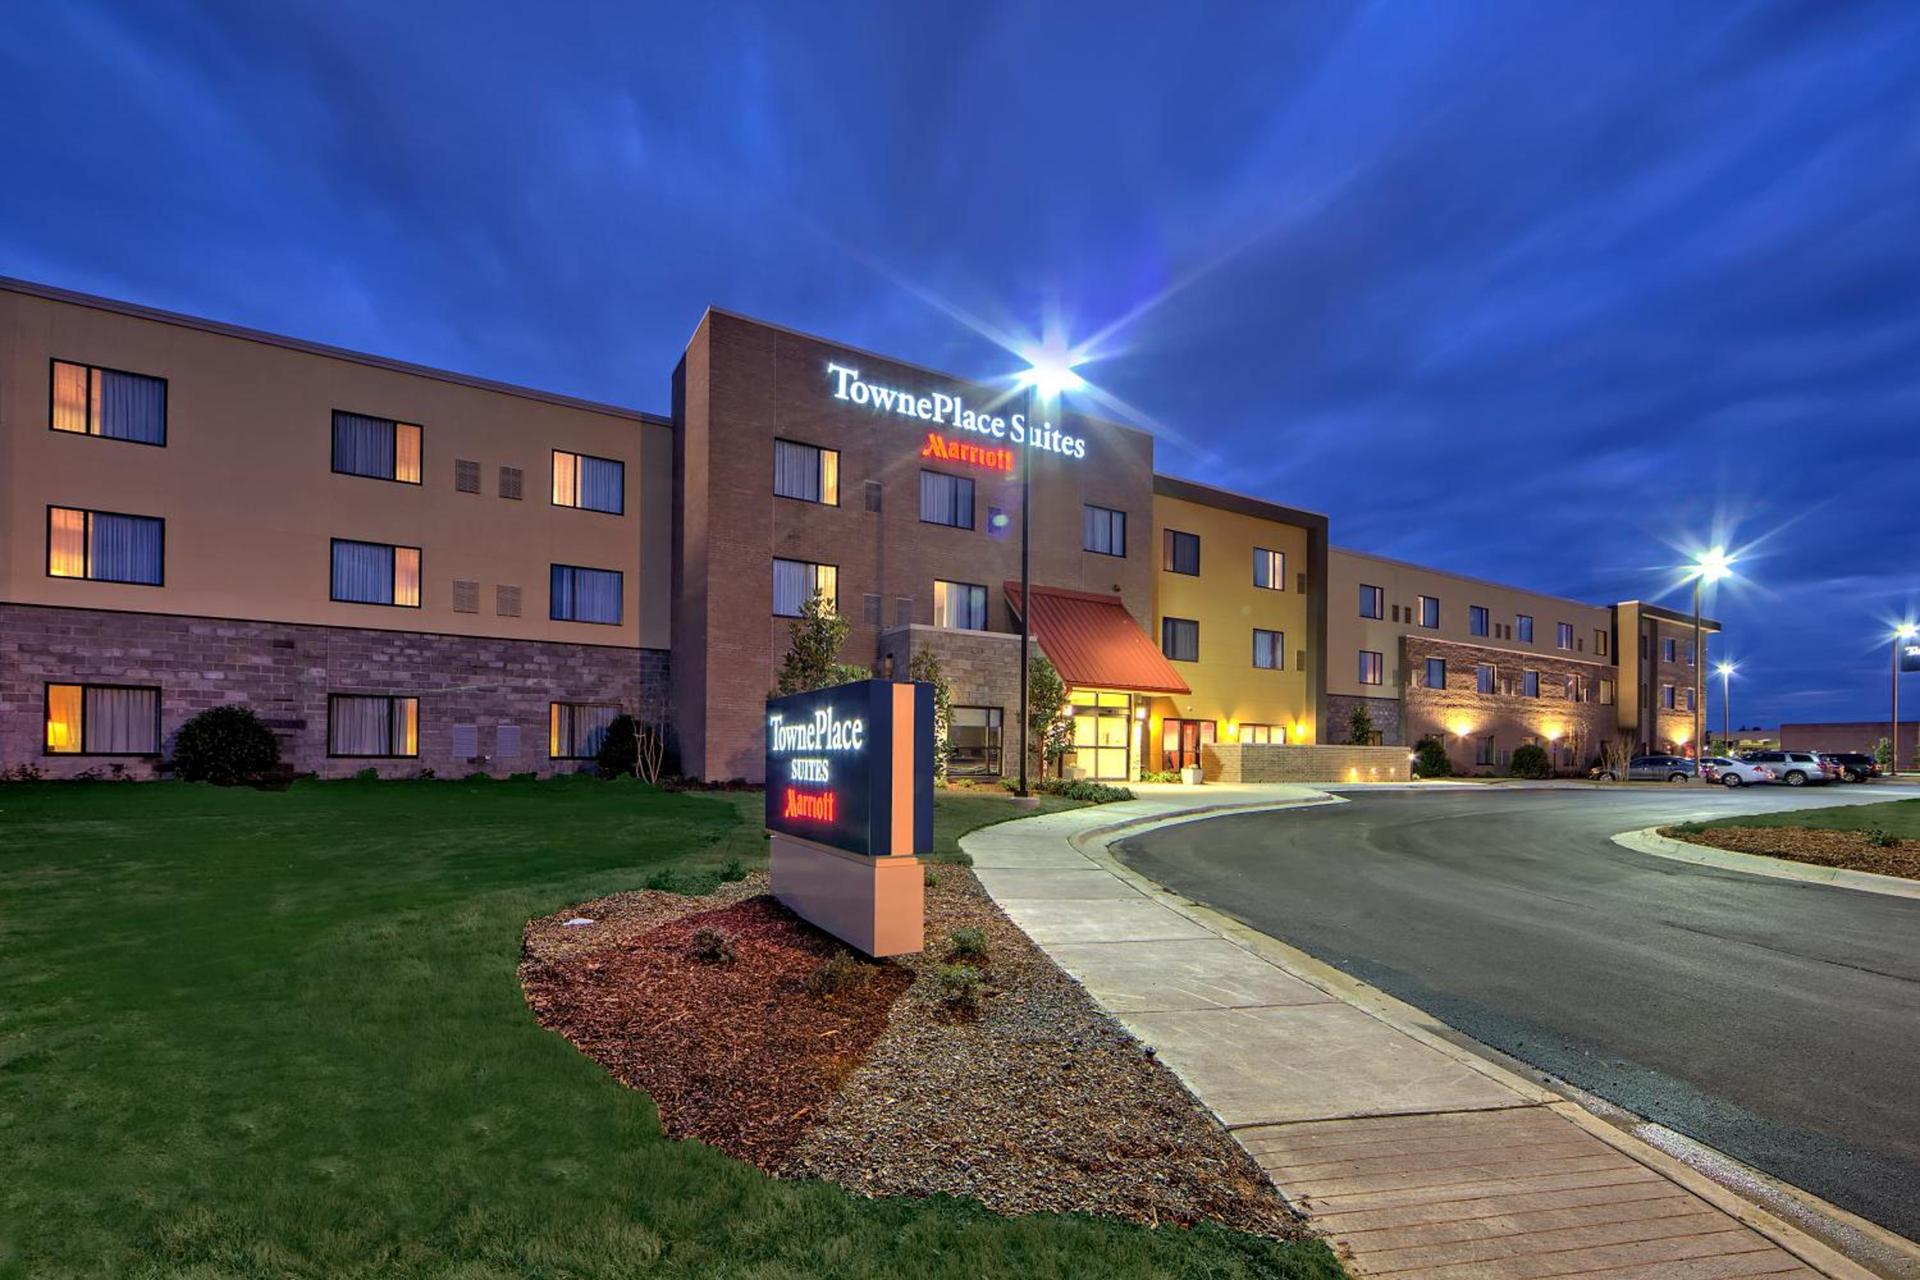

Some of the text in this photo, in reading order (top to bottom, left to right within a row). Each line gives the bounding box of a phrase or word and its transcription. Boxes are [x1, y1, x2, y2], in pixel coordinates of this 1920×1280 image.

[828, 362, 1085, 458] TownePlace Suites
[922, 433, 1014, 471] Marriott
[770, 707, 863, 751] TownePlace
[791, 758, 829, 782] SUITES
[785, 788, 834, 822] Marriott
